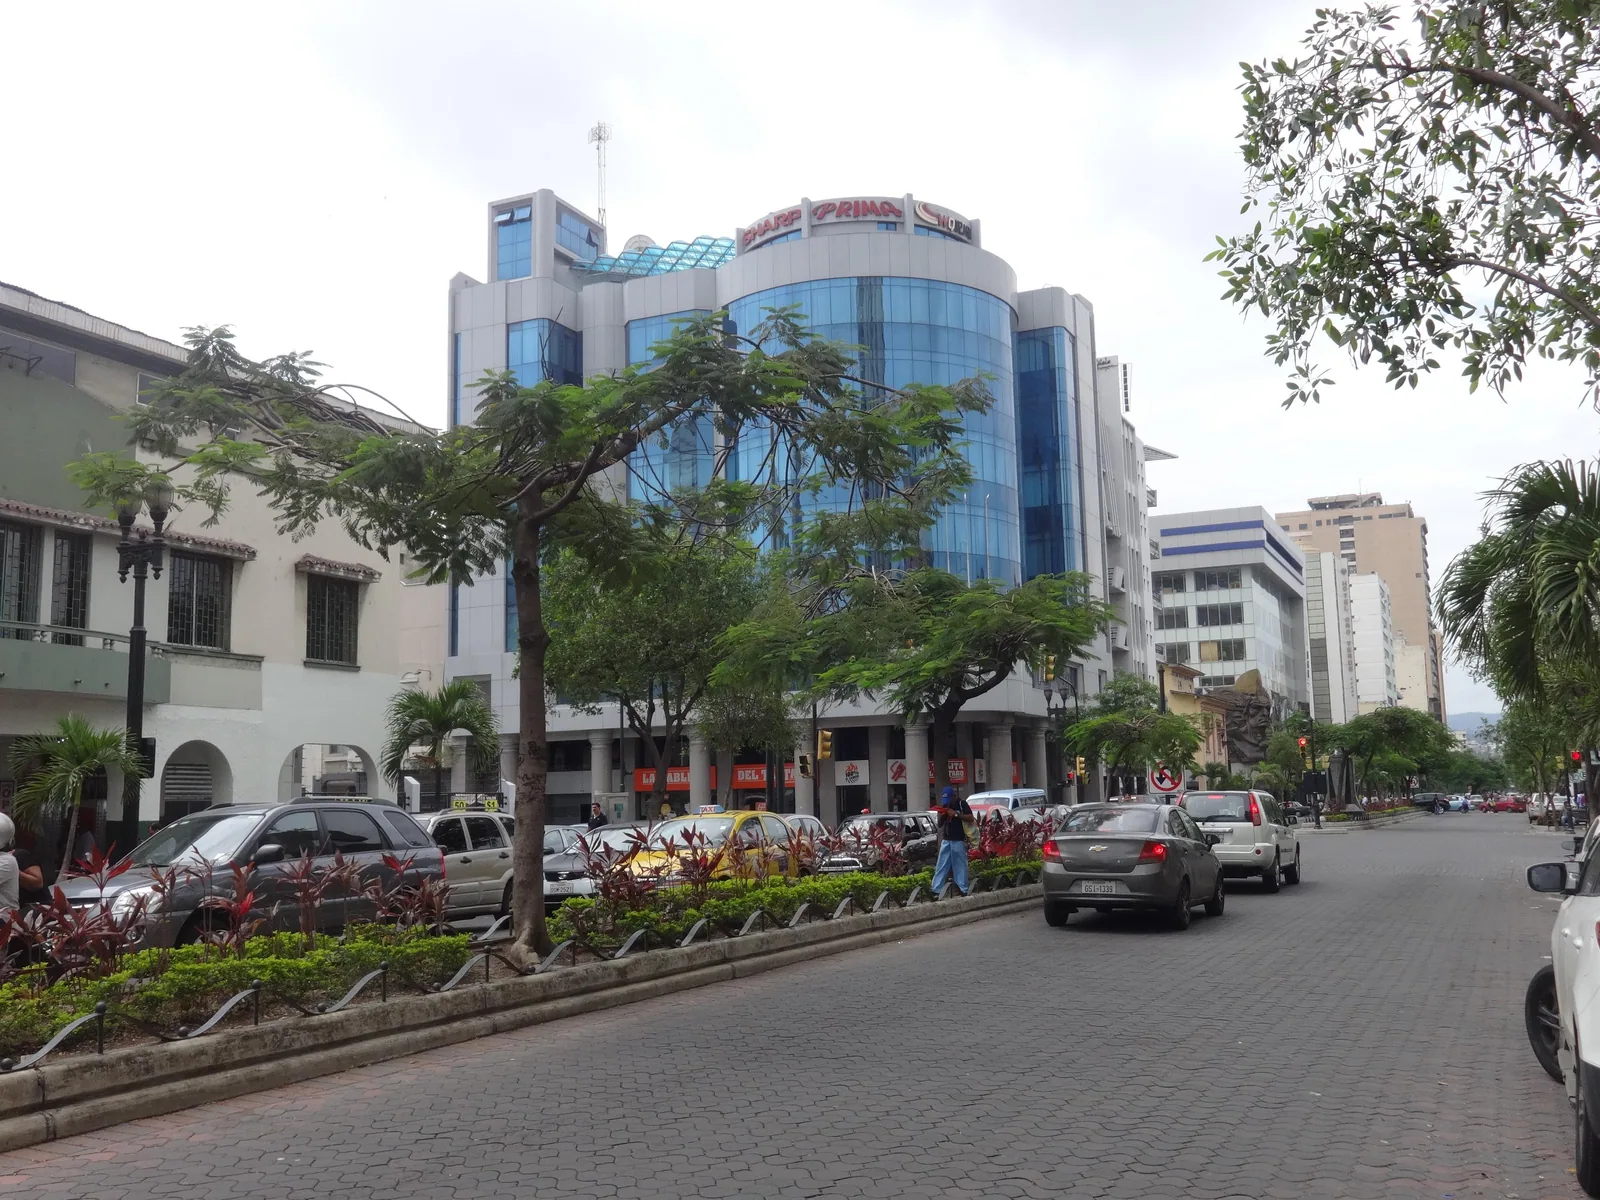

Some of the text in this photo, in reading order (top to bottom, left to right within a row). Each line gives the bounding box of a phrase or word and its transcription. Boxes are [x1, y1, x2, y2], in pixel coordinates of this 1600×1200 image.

[812, 200, 902, 220] PRIMA
[743, 209, 801, 246] SHARP
[642, 773, 656, 784] LA
[737, 769, 759, 781] DEL
[1084, 885, 1113, 893] GSI-1339
